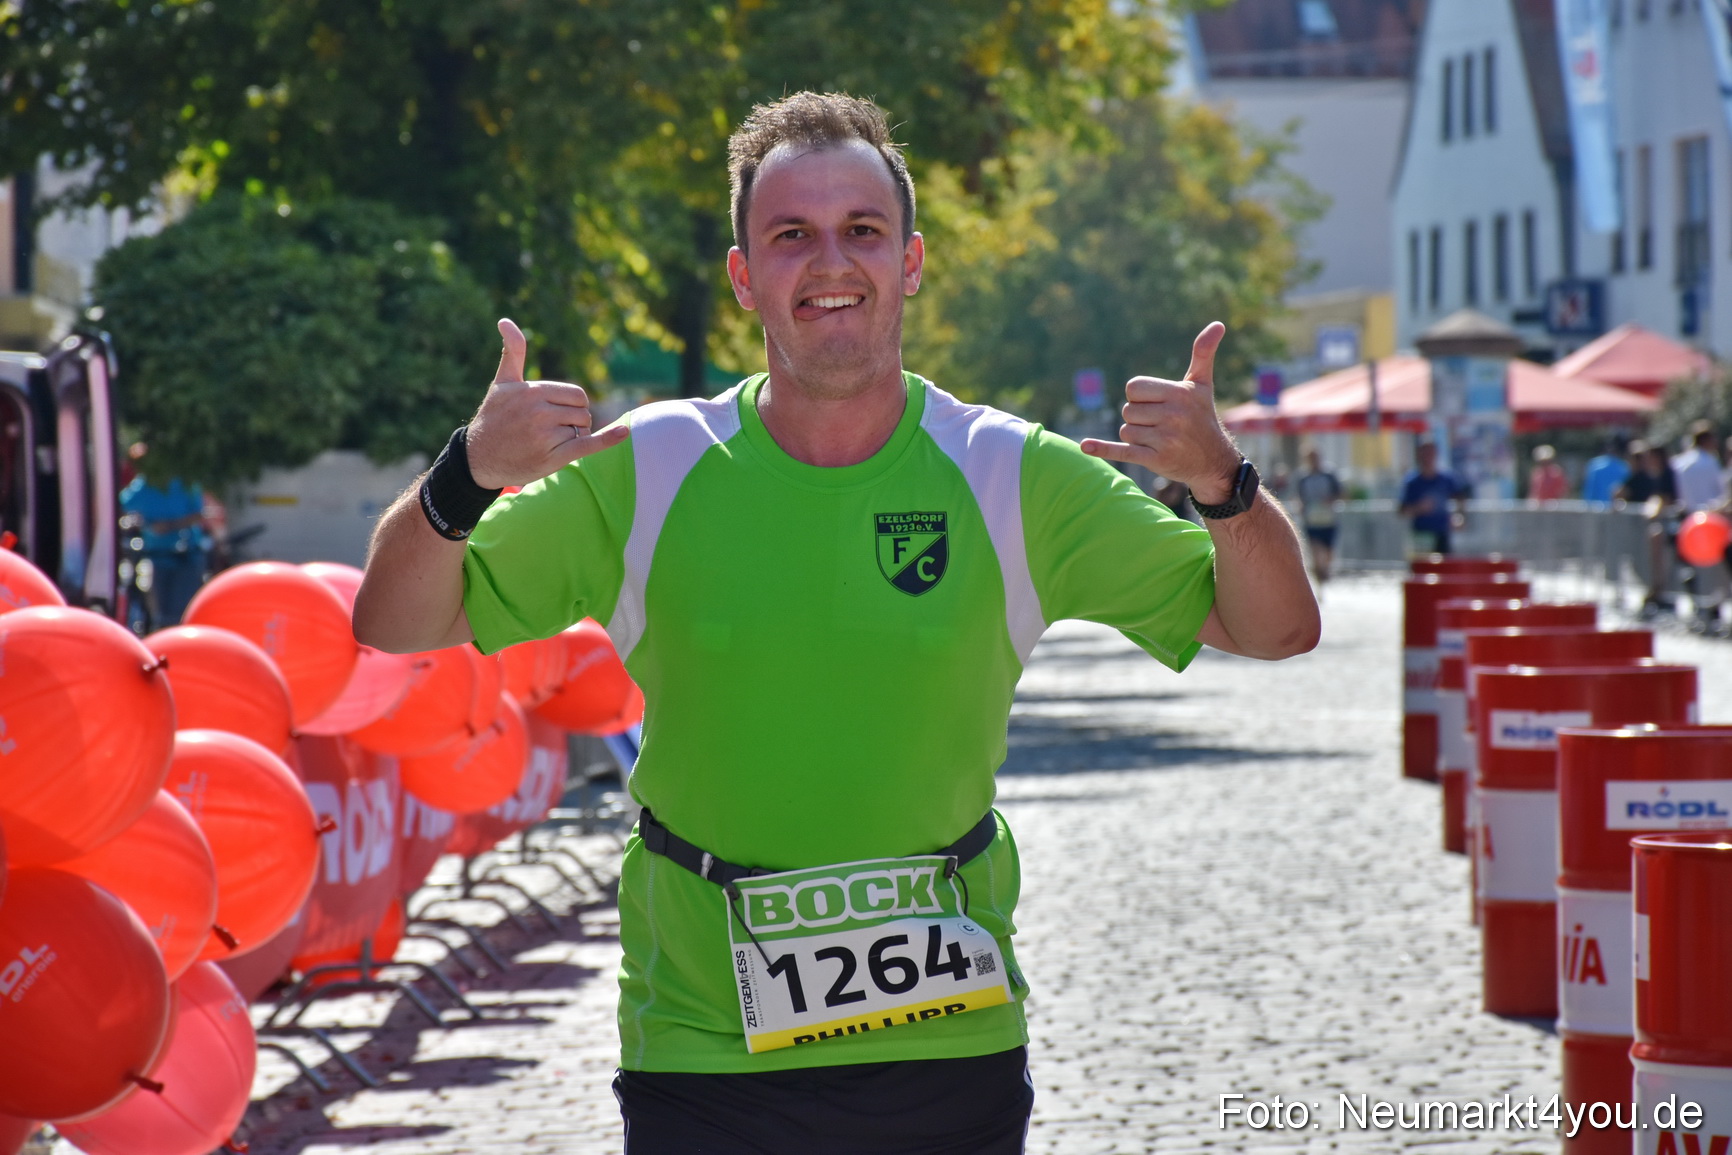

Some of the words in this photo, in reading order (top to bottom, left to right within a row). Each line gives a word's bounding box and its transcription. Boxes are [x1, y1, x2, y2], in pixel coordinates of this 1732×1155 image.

[423, 485, 449, 531] BIONIC
[878, 514, 944, 524] EZELSDORF
[893, 537, 911, 564] F
[917, 556, 937, 582] C
[746, 866, 945, 930] BOCK
[766, 924, 972, 1014] 1264
